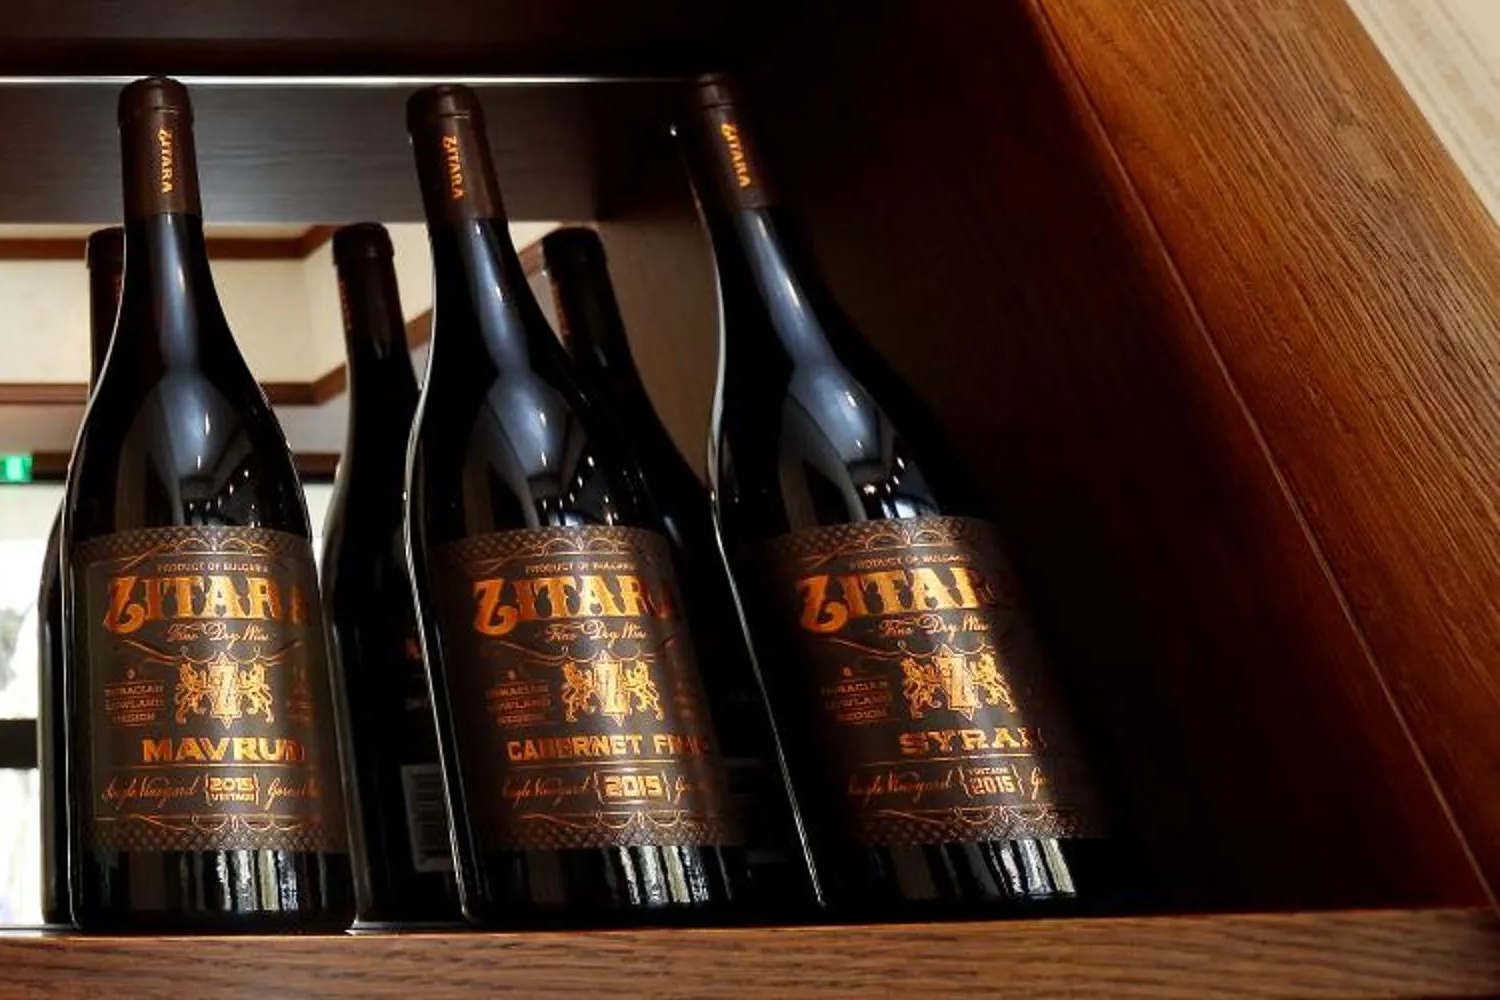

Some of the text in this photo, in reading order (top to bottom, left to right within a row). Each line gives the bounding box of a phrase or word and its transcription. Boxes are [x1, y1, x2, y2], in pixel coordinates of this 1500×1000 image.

[157, 127, 173, 193] ZITARA
[209, 777, 255, 791] 2015
[604, 775, 664, 798] 2015
[970, 774, 1017, 796] 2015
